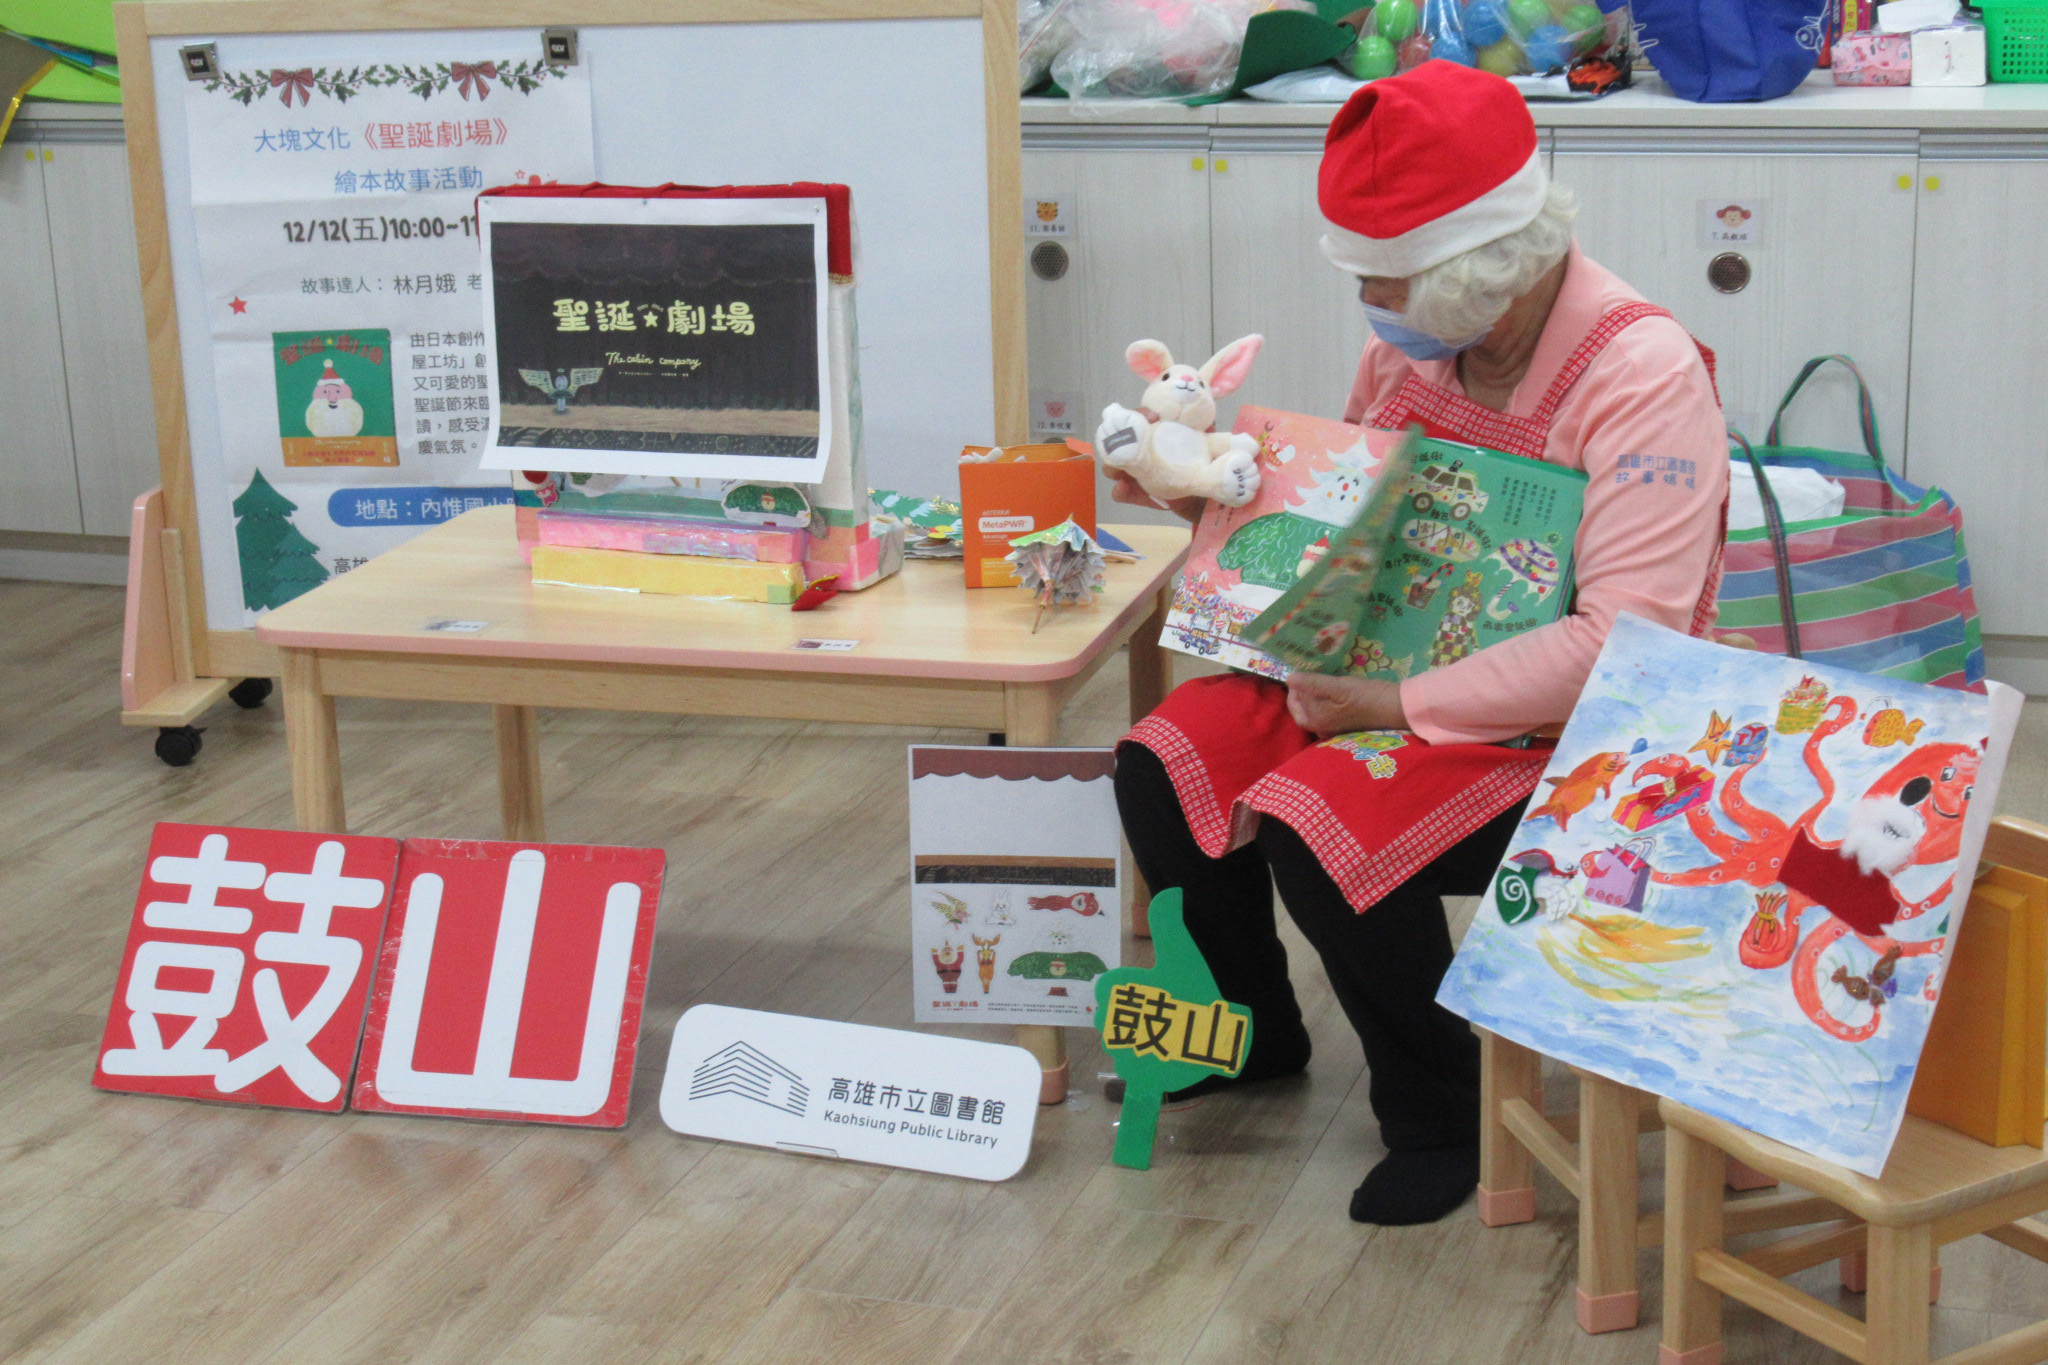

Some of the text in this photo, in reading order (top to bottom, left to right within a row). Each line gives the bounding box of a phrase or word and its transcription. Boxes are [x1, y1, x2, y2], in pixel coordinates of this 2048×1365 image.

[254, 118, 508, 153] 大塊文化 《聖誕劇場》
[334, 165, 484, 194] 繪本故事活動
[301, 277, 383, 294] 故事達人：
[394, 272, 457, 295] 林月娥
[418, 440, 478, 455] 慶氣氛。
[355, 499, 413, 520] 地點：
[101, 833, 642, 1117] 鼓山
[1108, 986, 1244, 1071] 鼓山
[828, 1077, 1006, 1125] 高雄市立圖書館
[823, 1109, 998, 1149] Kaohsiung Public Library
